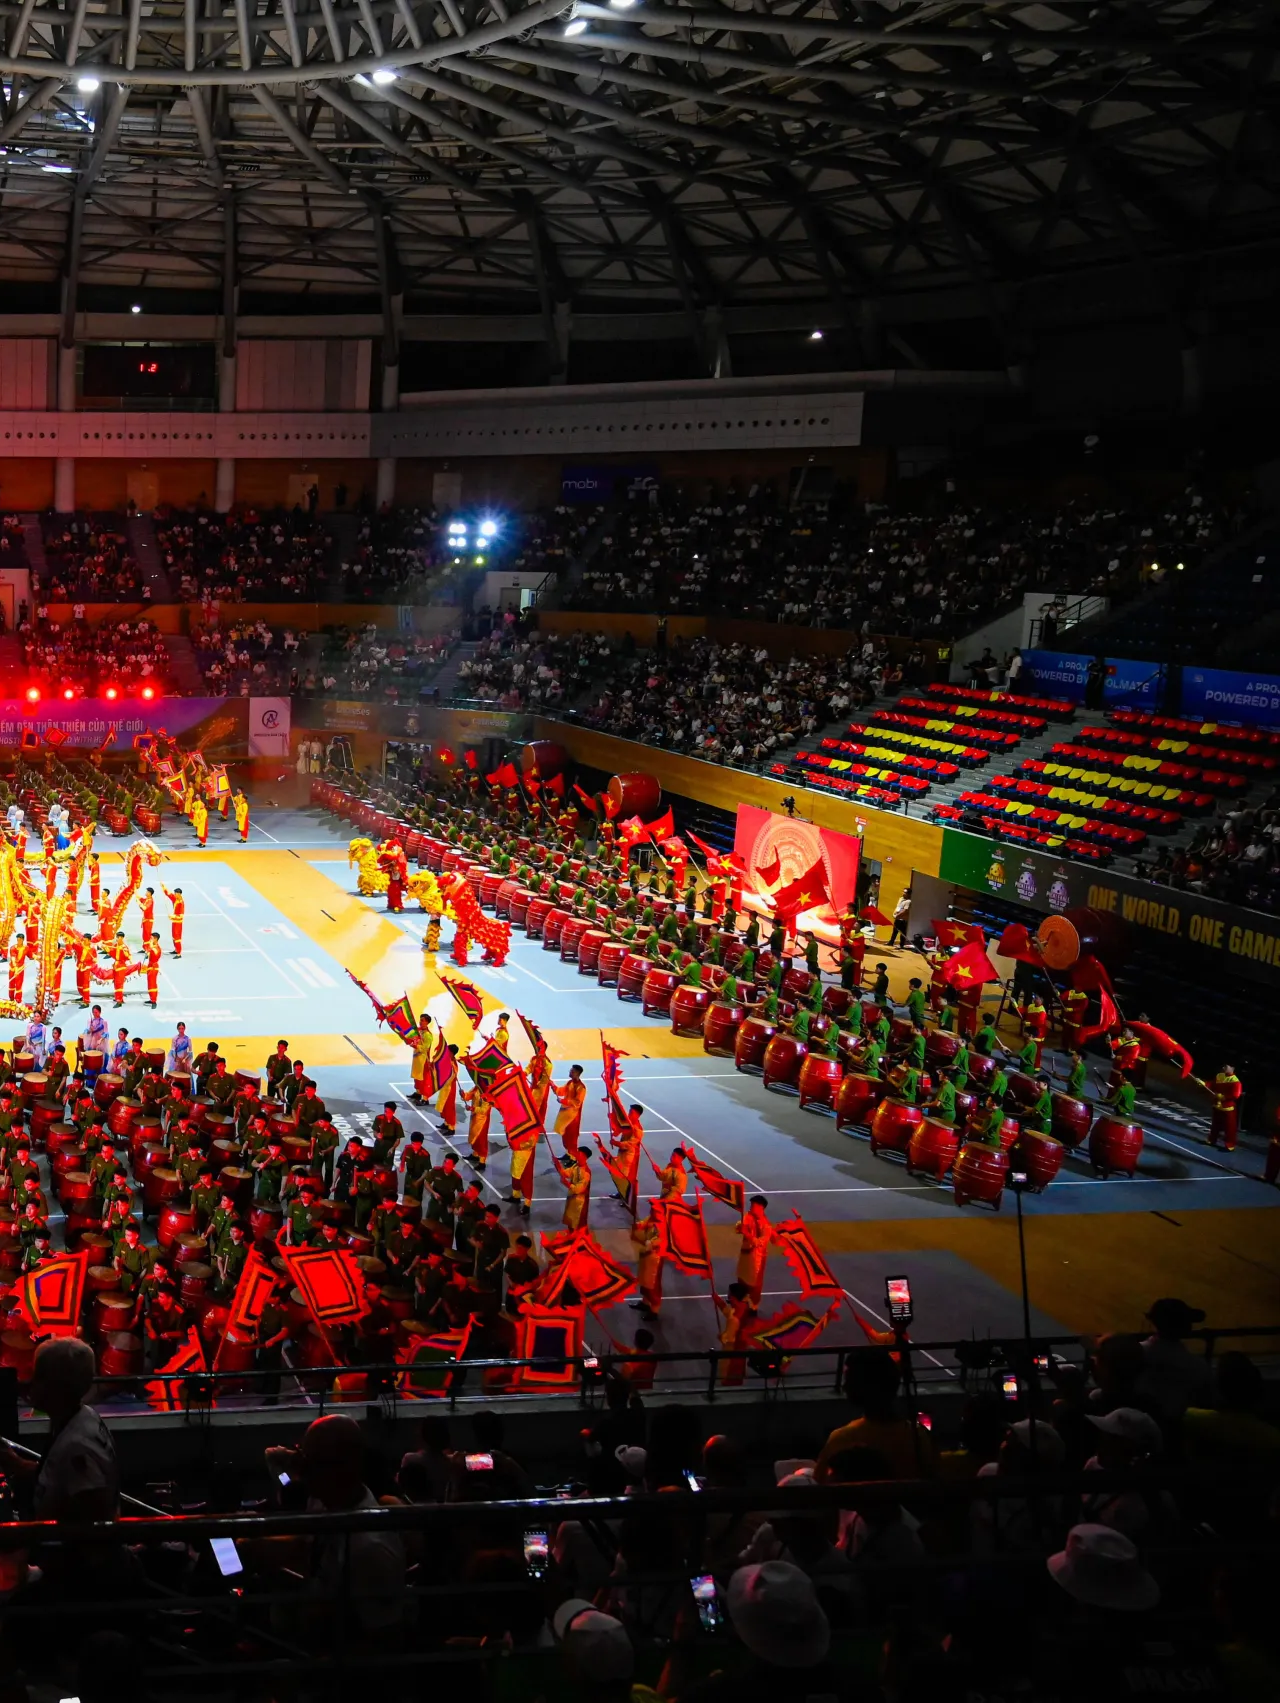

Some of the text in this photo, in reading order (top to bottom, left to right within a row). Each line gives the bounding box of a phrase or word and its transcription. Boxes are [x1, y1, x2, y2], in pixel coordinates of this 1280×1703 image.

[1065, 661, 1088, 672] PROJ
[1105, 678, 1150, 693] OLMATE
[1205, 690, 1269, 708] POWERED
[1087, 884, 1119, 912] ONE
[1188, 914, 1225, 949] ONE
